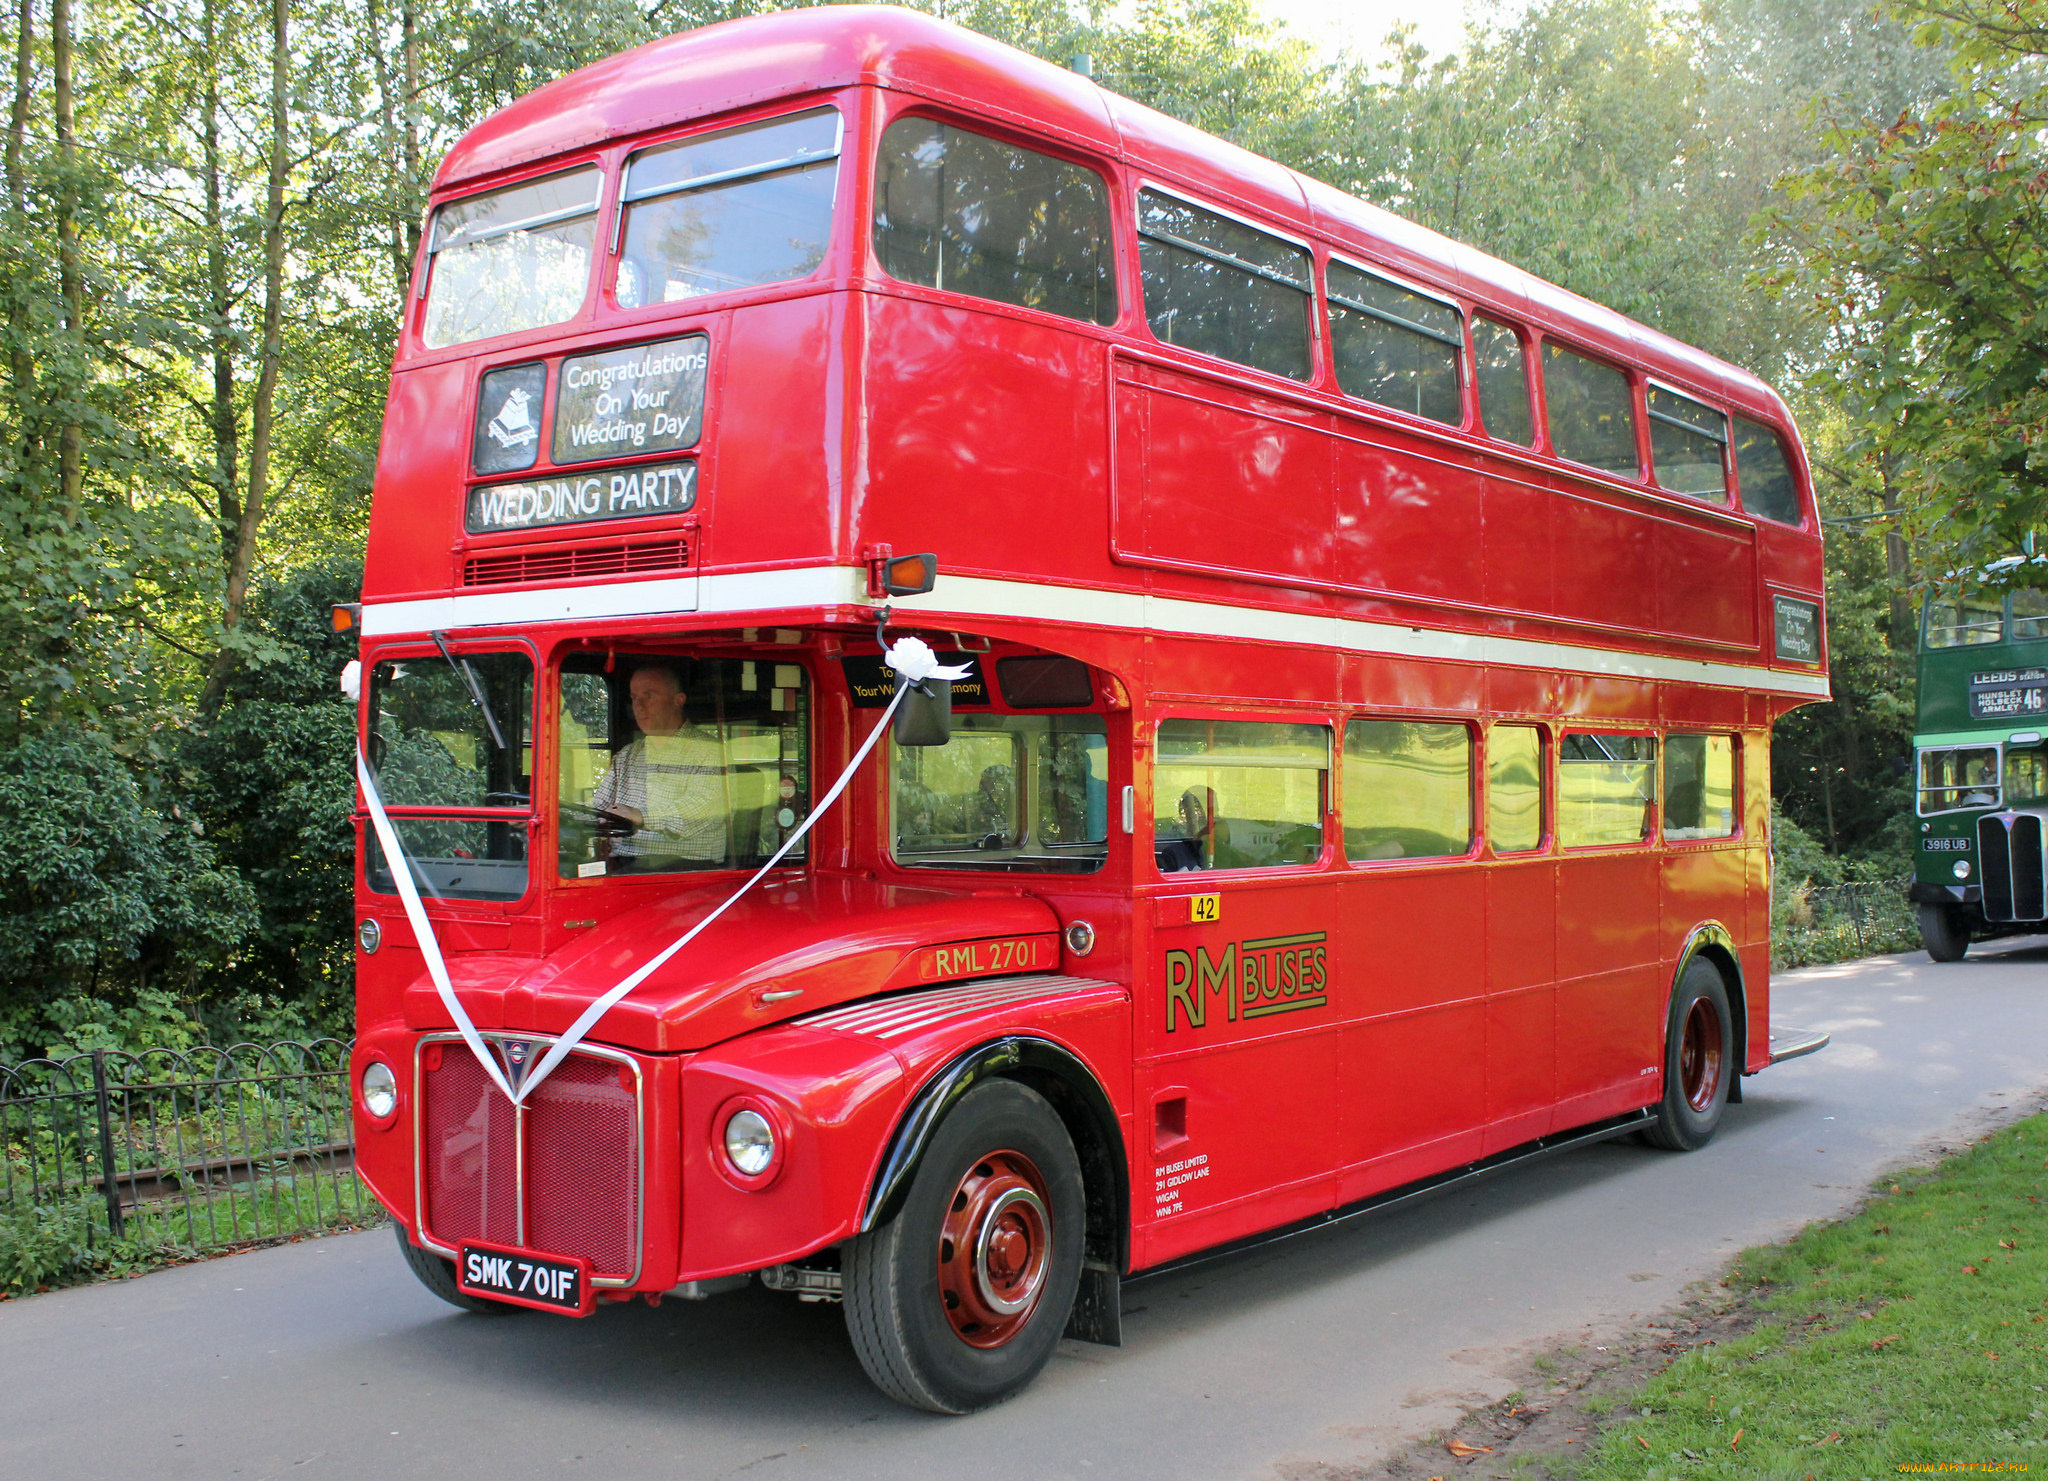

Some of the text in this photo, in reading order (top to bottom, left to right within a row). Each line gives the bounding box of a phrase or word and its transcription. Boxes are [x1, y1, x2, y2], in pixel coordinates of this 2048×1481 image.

[567, 352, 707, 391] Congratulations
[595, 388, 669, 416] On Your
[571, 413, 691, 447] Wedding Day
[480, 466, 697, 526] WEDDING PARTY
[879, 666, 894, 678] To
[1974, 671, 2017, 685] LEEDS
[854, 685, 879, 697] Your
[1978, 689, 2022, 701] HUNSLET
[1978, 696, 2023, 707] HOLBECK
[2023, 688, 2043, 710] 46
[1982, 703, 2020, 714] ARMLEY
[1926, 839, 1967, 850] 3916 UB
[1196, 897, 1215, 920] 42
[936, 941, 1037, 977] RML 2701
[1166, 942, 1328, 1034] RM BUSES
[1155, 1154, 1208, 1177] RM BUSES LIMITED
[1155, 1166, 1210, 1191] 291 GIDLOW LANE
[1155, 1189, 1179, 1204] WIGAN
[1155, 1201, 1183, 1218] WN6 7PE
[467, 1253, 575, 1300] SMK 701F
